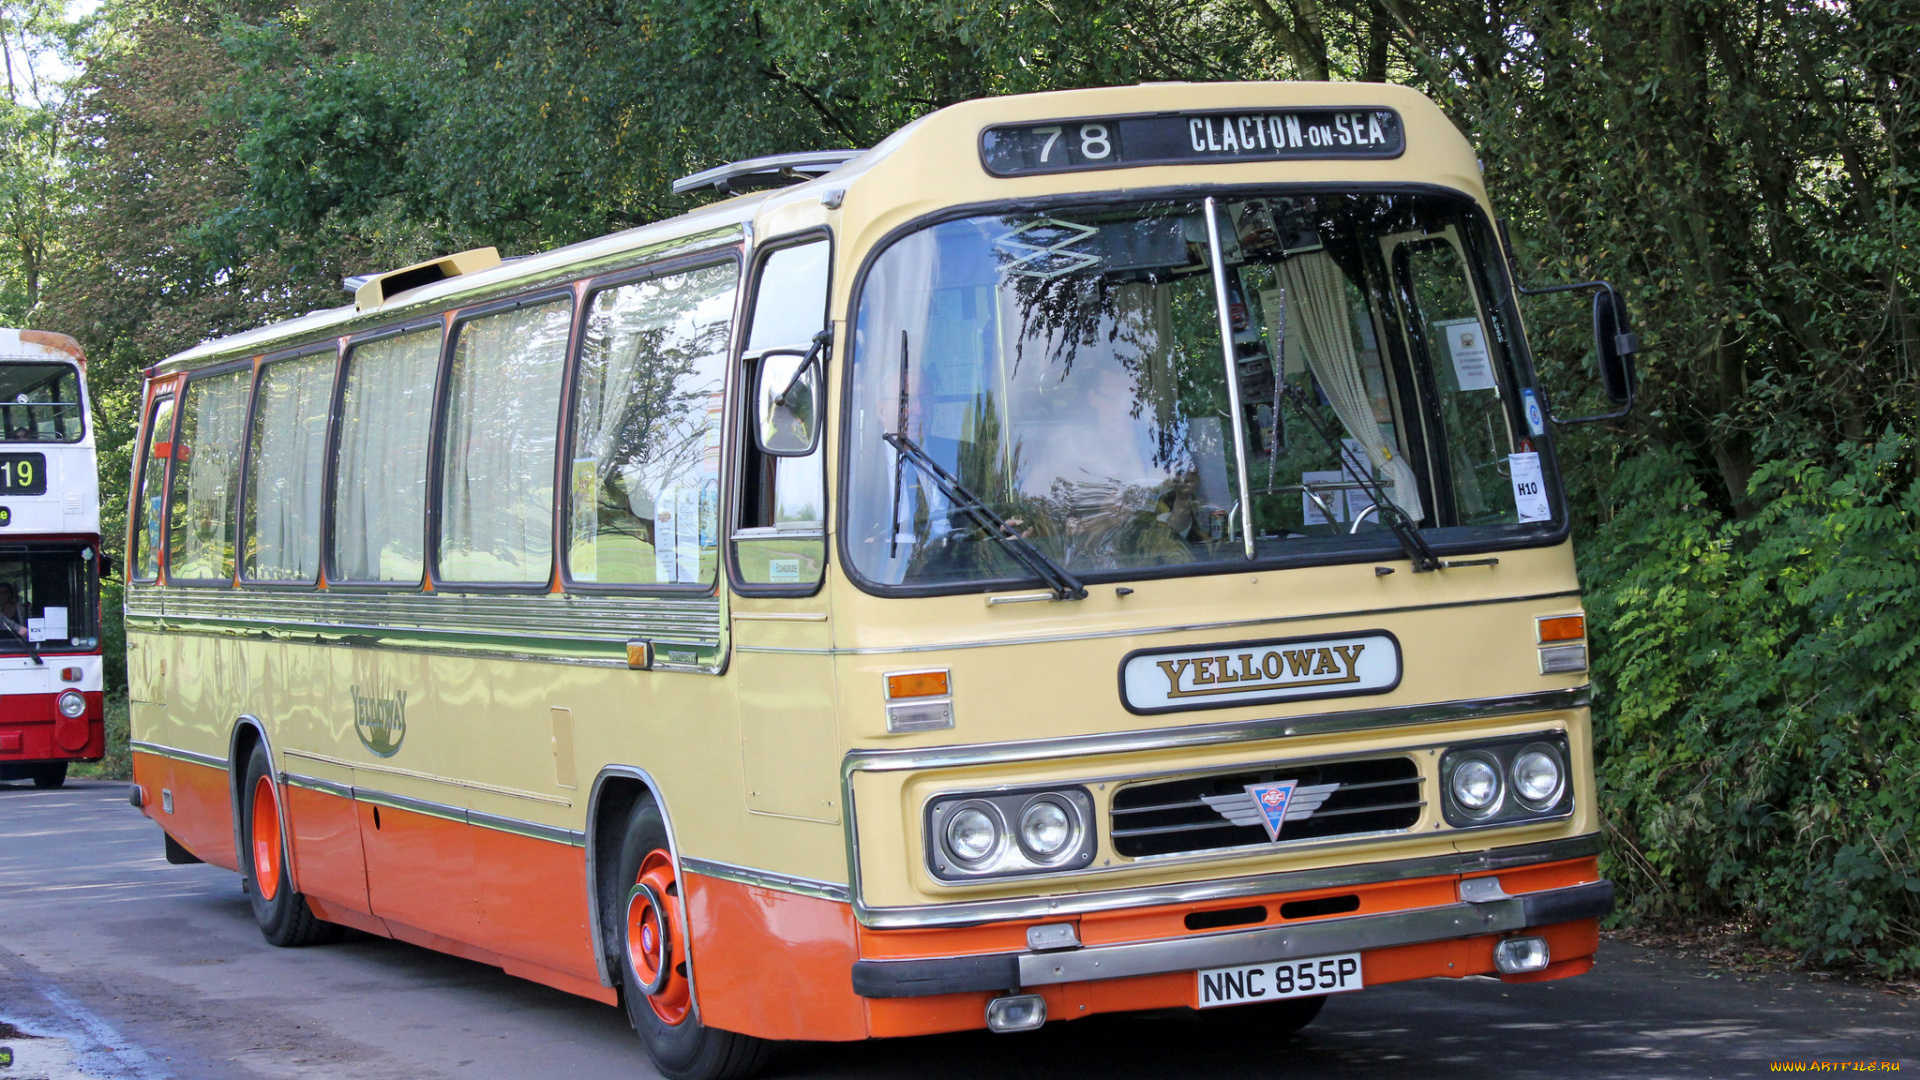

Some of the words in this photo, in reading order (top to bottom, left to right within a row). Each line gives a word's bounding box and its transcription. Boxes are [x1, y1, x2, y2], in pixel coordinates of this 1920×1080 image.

[1, 460, 33, 488] 19
[1517, 481, 1538, 496] H10
[1157, 644, 1365, 699] YELLOWAY
[1263, 792, 1284, 802] AEC
[1203, 969, 1266, 1002] NNC
[1275, 958, 1357, 993] 855P
